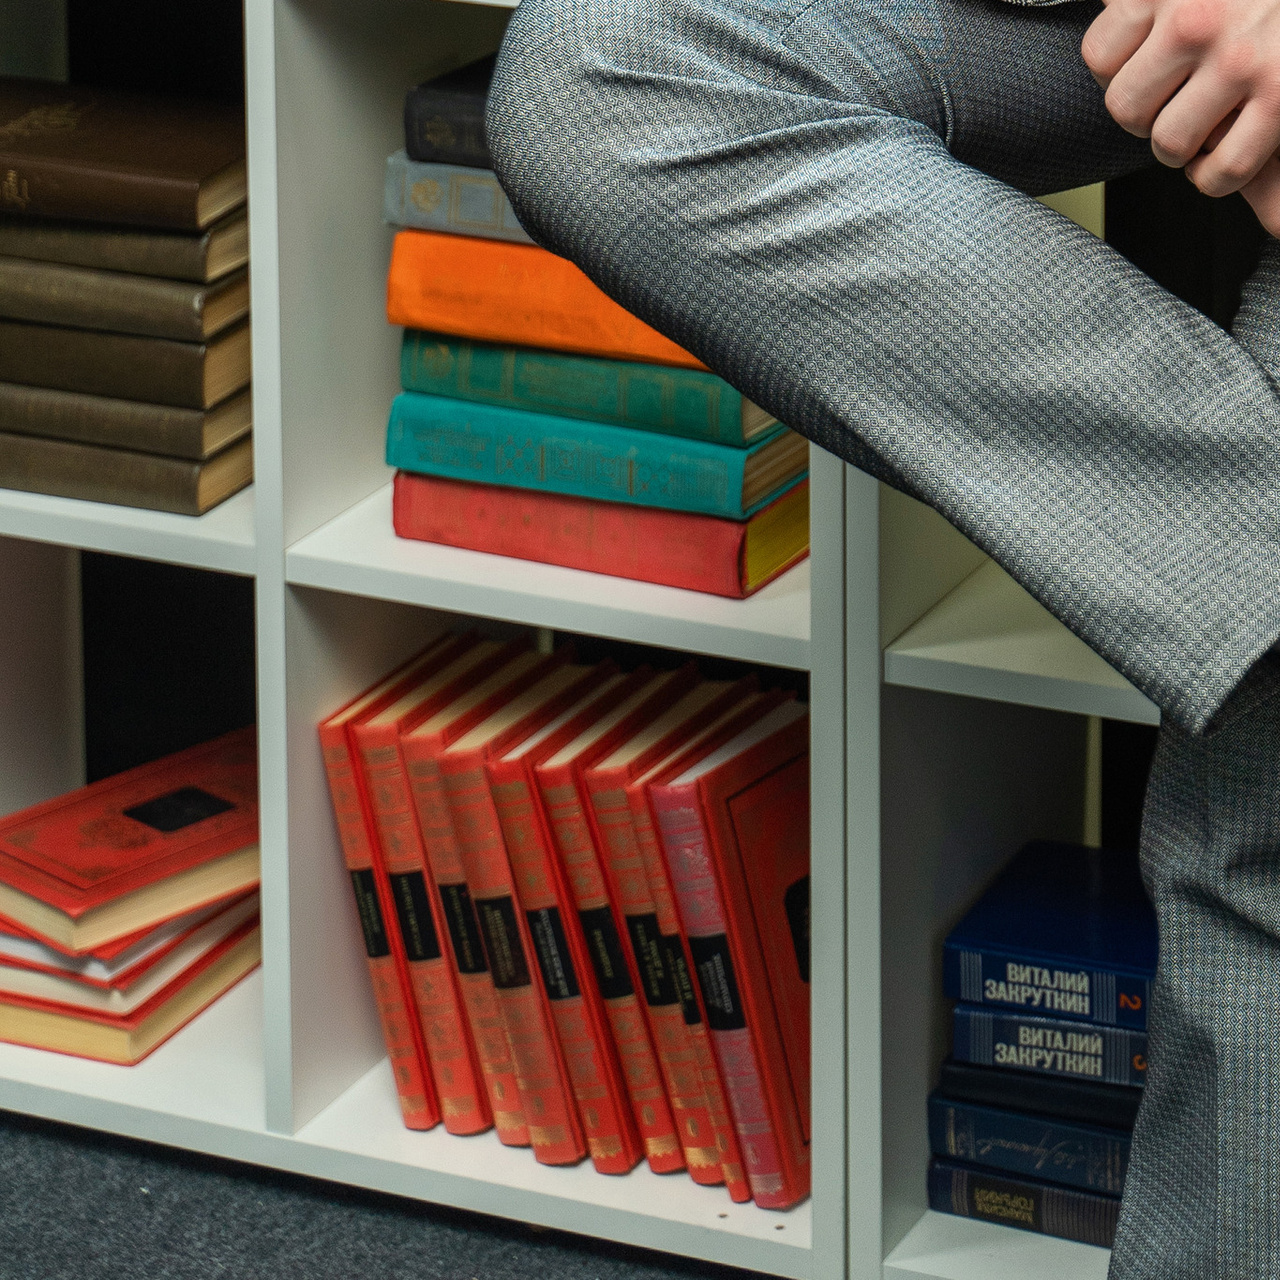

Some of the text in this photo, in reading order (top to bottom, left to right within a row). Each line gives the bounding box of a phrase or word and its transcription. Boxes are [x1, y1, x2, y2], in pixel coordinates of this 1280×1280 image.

[1006, 961, 1090, 993] ВИТАЛИЙ
[984, 978, 1090, 1016] ЗАКРУТКИН
[1018, 1024, 1103, 1056] ВИТАЛИЙ
[995, 1042, 1102, 1077] ЗАКРУТКИН
